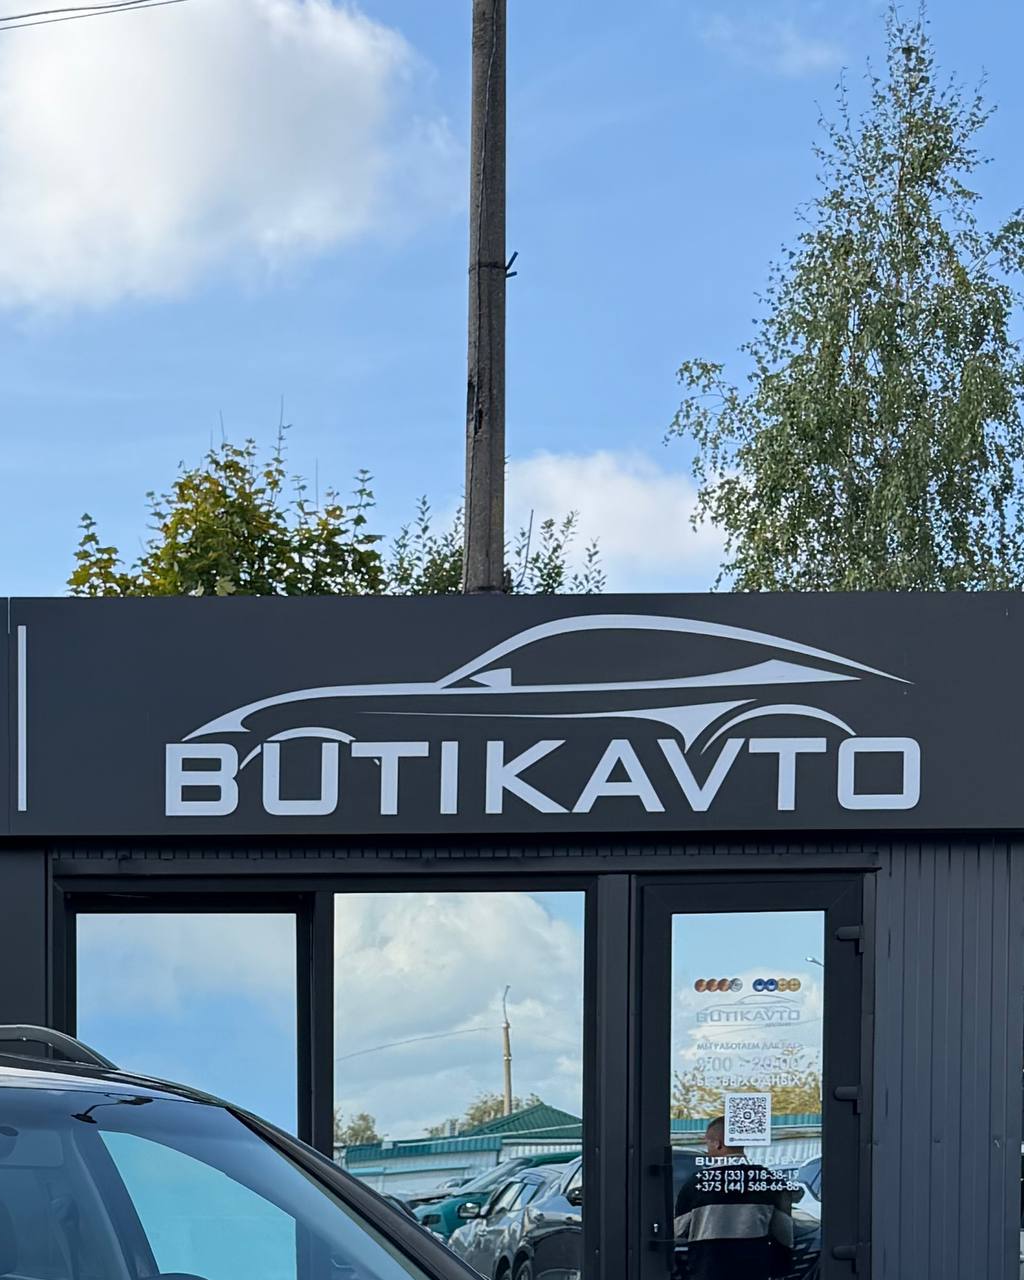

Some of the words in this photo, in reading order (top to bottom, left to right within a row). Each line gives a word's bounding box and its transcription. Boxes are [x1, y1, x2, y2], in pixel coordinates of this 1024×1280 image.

[165, 736, 921, 817] BUTIKAVTO
[696, 1010, 800, 1022] BUTIKAVTO
[696, 1170, 722, 1180] +375
[725, 1169, 745, 1181] (33)
[696, 1182, 722, 1192] +375
[725, 1181, 745, 1194] (44)
